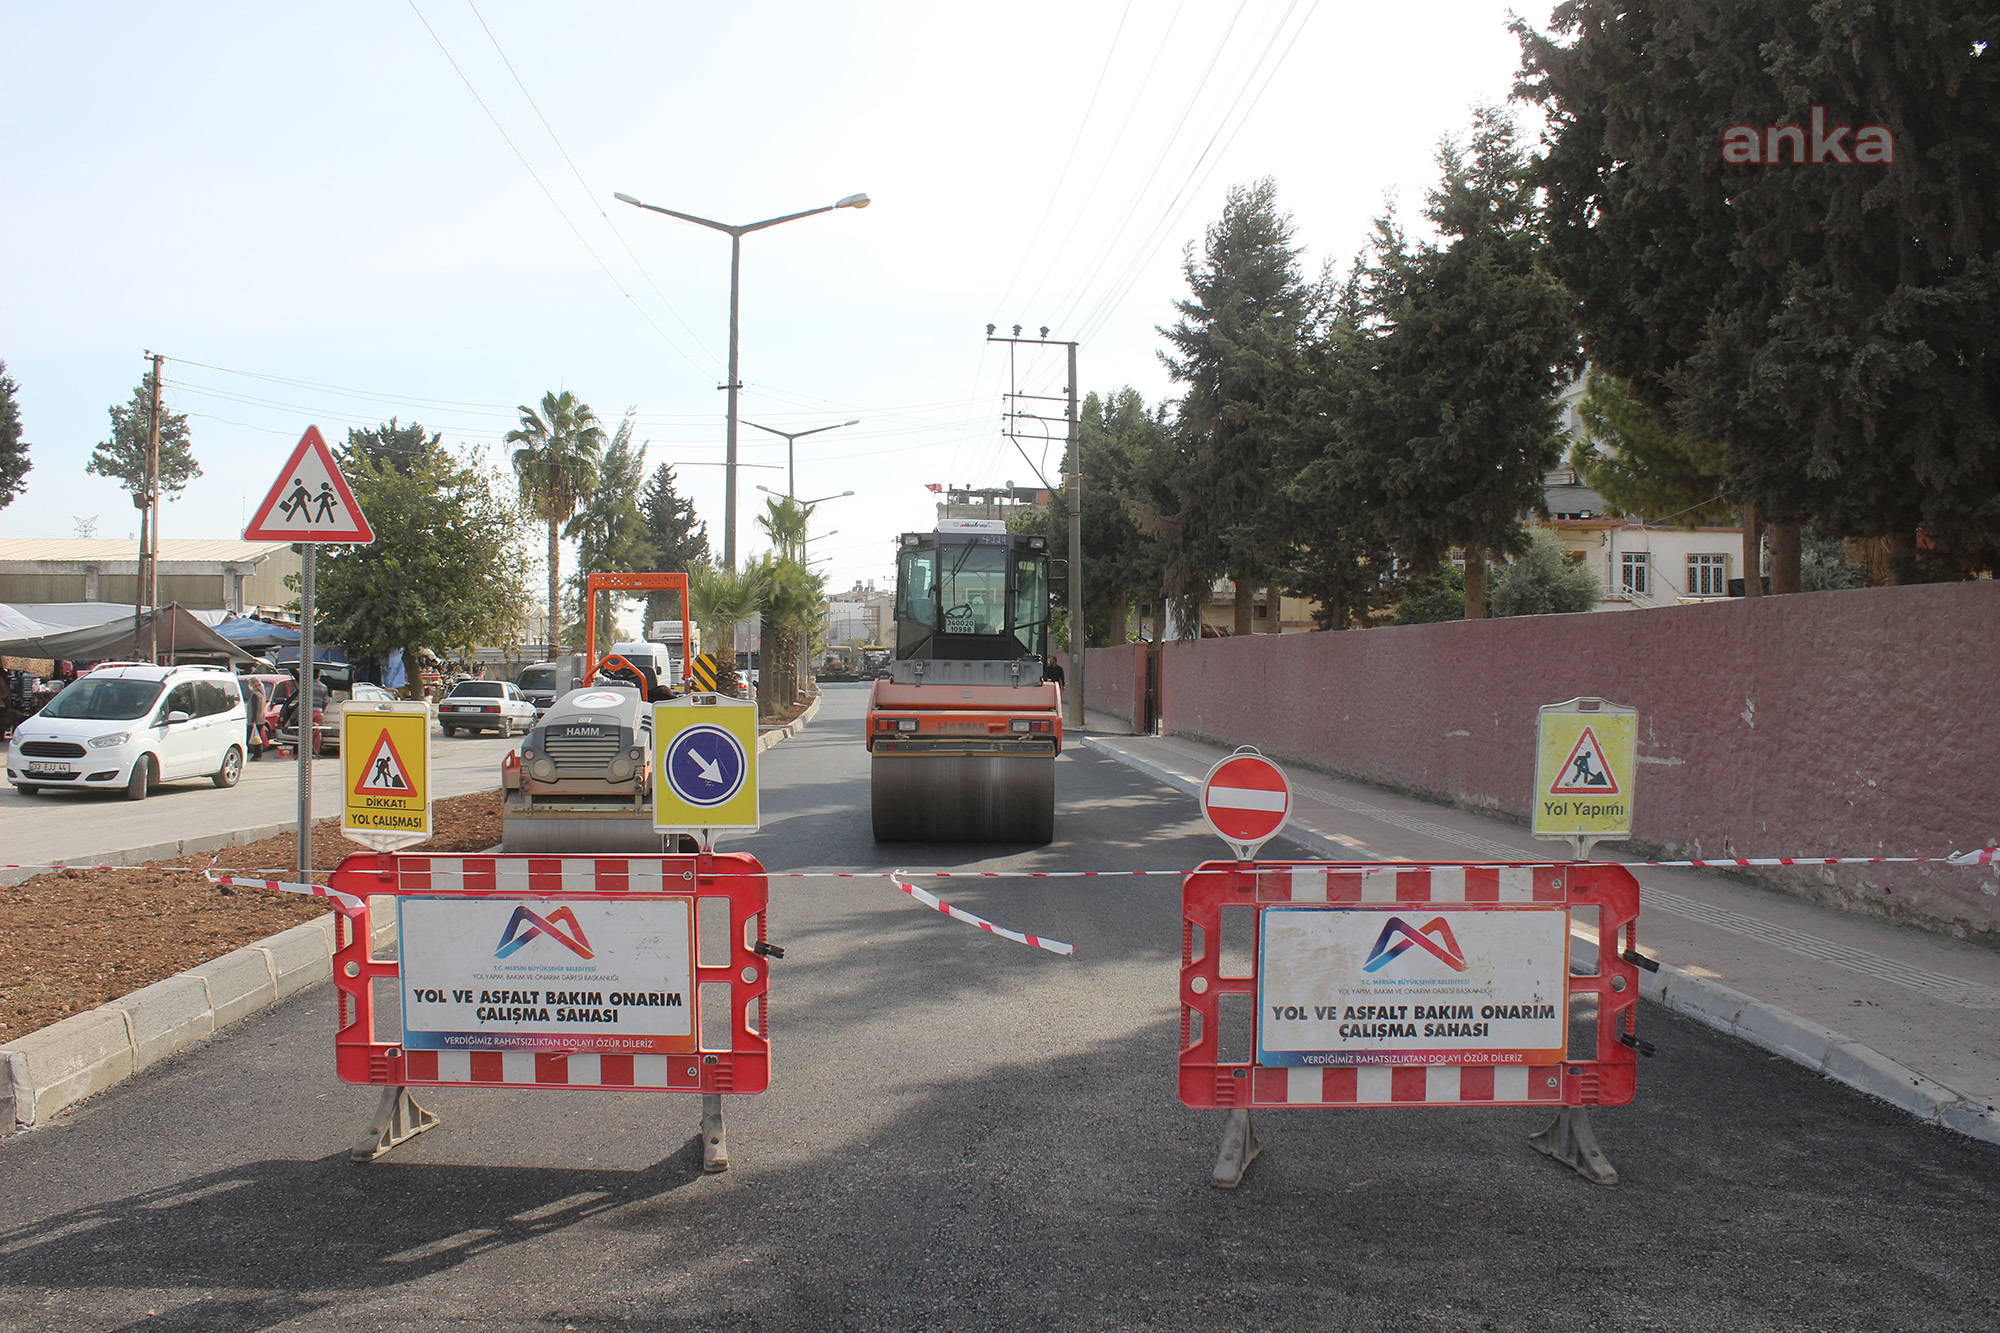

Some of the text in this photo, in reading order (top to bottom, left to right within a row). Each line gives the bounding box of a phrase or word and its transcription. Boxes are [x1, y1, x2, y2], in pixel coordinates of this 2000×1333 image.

[982, 535, 1007, 545] 4224
[566, 727, 600, 736] HAMM
[938, 722, 985, 732] HAMM
[366, 795, 407, 808] DİKKAT!
[1544, 802, 1624, 819] Yol Yapımı
[352, 814, 422, 829] YOL ÇALIŞMASI
[413, 989, 682, 1007] YOL VE ASFALT BAKIM ONARIM
[476, 1006, 618, 1024] ÇALIŞMA SAHASI
[1272, 1004, 1556, 1021] YOL VE ASFALT BAKIM ONARIM
[1338, 1022, 1489, 1042] ÇALIŞMA SAHASI
[444, 1035, 654, 1049] VERDİĞİMİZ RAHATSIZLIKTAN DOLAYI ÖZÜR DİLERİZ
[1302, 1051, 1523, 1064] VERDİĞİMİZ RAHATSIZLIKTAN DOLAYI ÖZÜR DİLERİZ
